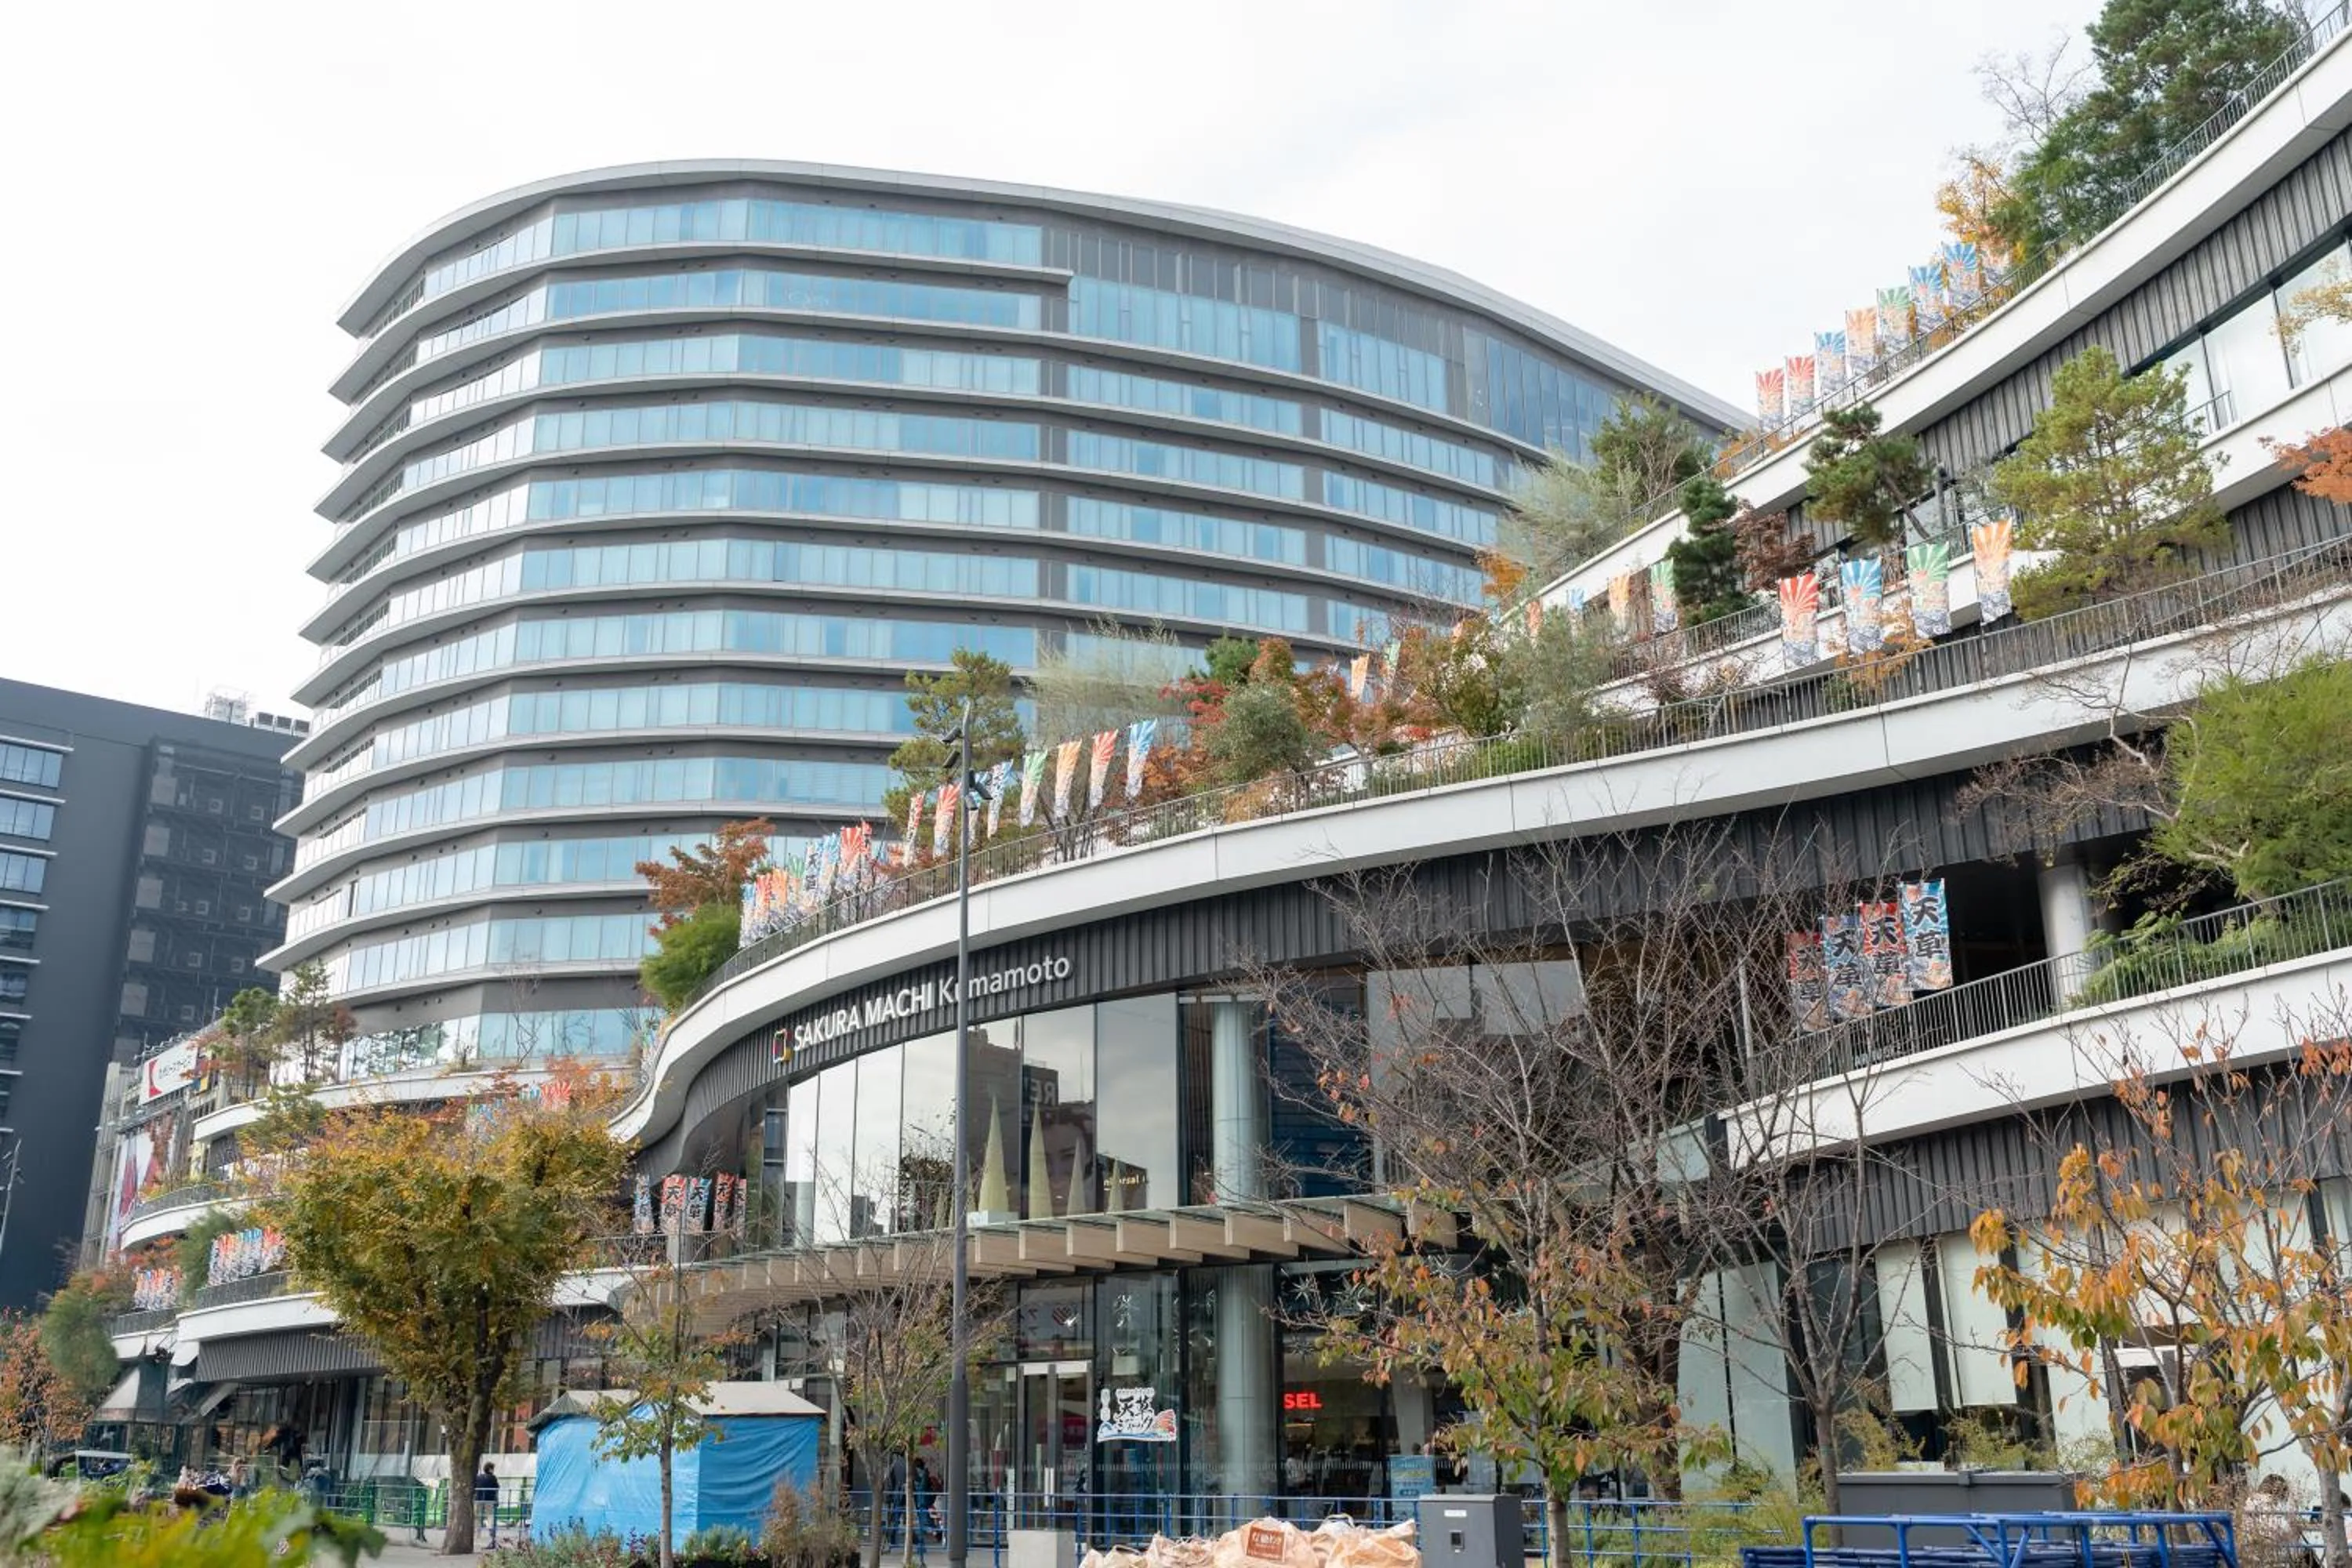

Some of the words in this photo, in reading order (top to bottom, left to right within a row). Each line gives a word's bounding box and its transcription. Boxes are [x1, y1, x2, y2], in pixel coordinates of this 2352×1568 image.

[1869, 916, 1900, 975] 天草
[1911, 897, 1944, 958] 天草
[1832, 929, 1863, 988] 天草
[793, 1005, 862, 1052] SAKURA
[865, 982, 933, 1025] MACHI
[1284, 1392, 1322, 1409] SEL
